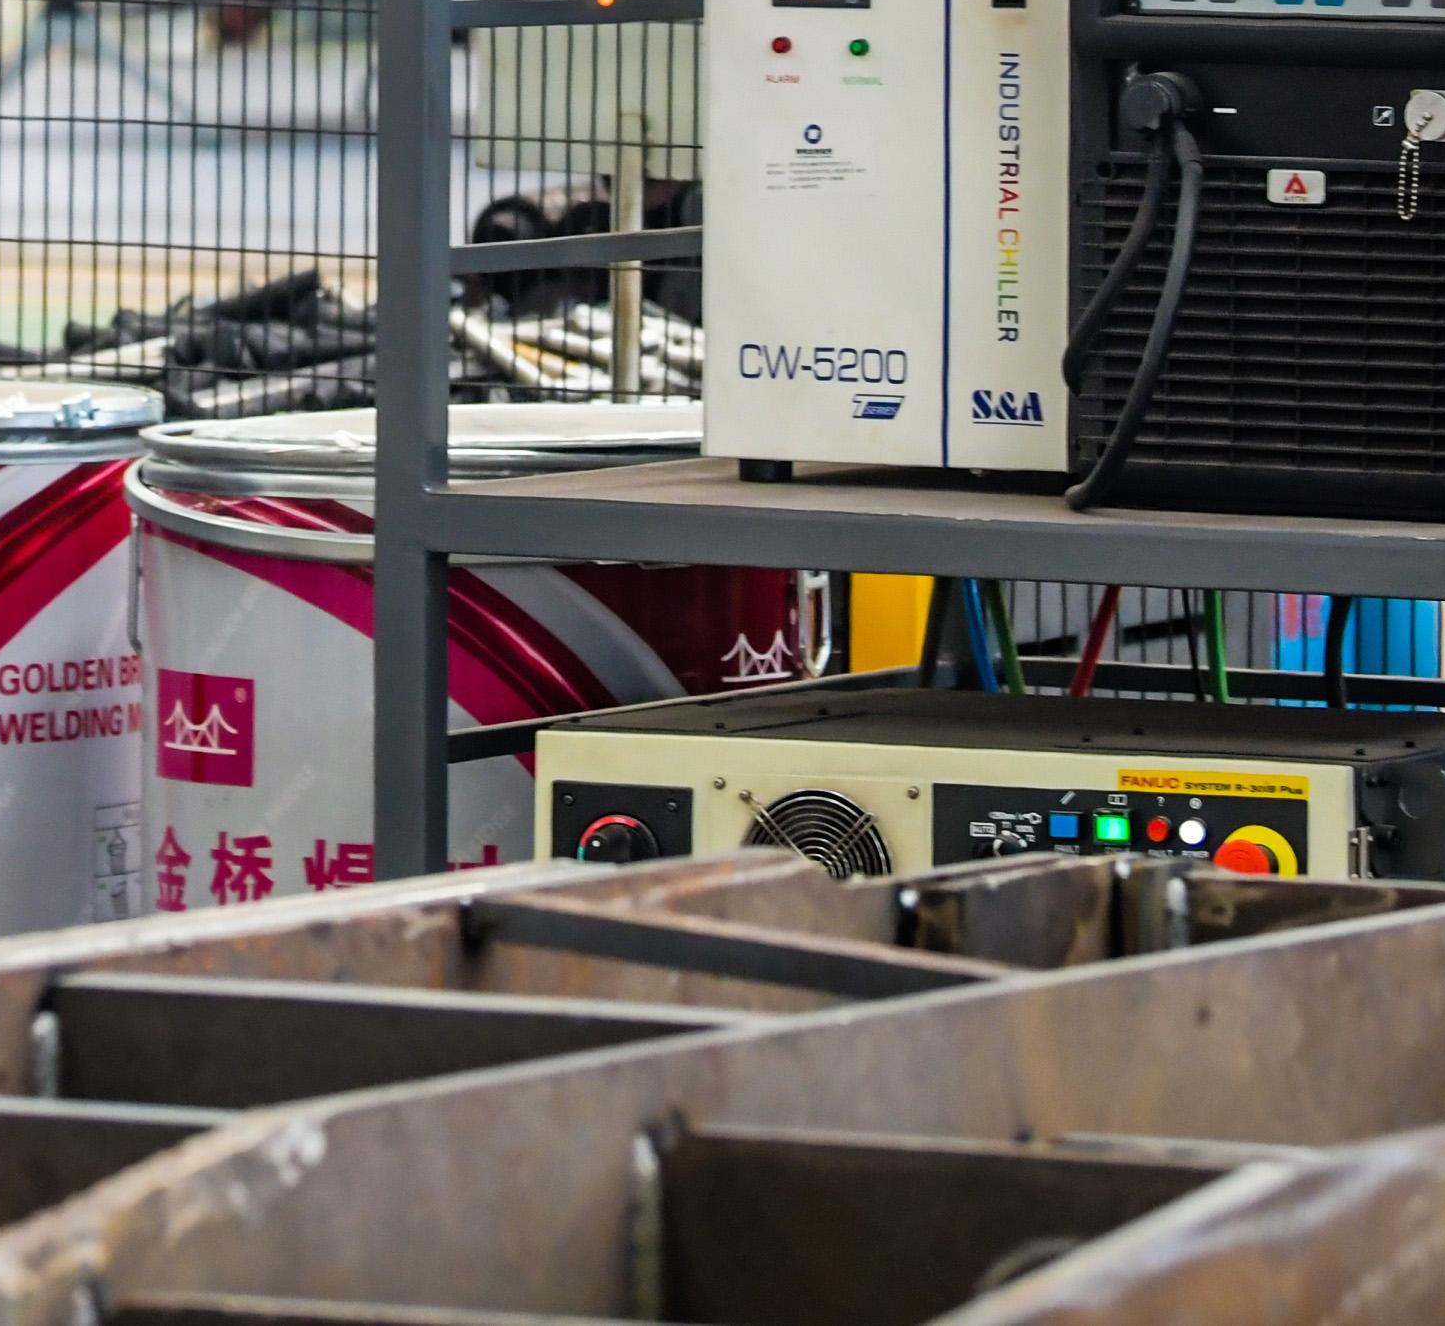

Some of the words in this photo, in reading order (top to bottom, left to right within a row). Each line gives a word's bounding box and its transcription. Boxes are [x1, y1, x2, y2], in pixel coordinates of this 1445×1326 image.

[998, 52, 1021, 221] INDUSTRIAL
[997, 228, 1021, 343] CHILLER
[739, 343, 908, 385] CW-5200
[971, 388, 1044, 422] S&A
[1121, 774, 1181, 790] FANUC
[1184, 781, 1233, 794] SYSTEM
[1280, 785, 1305, 796] Plus
